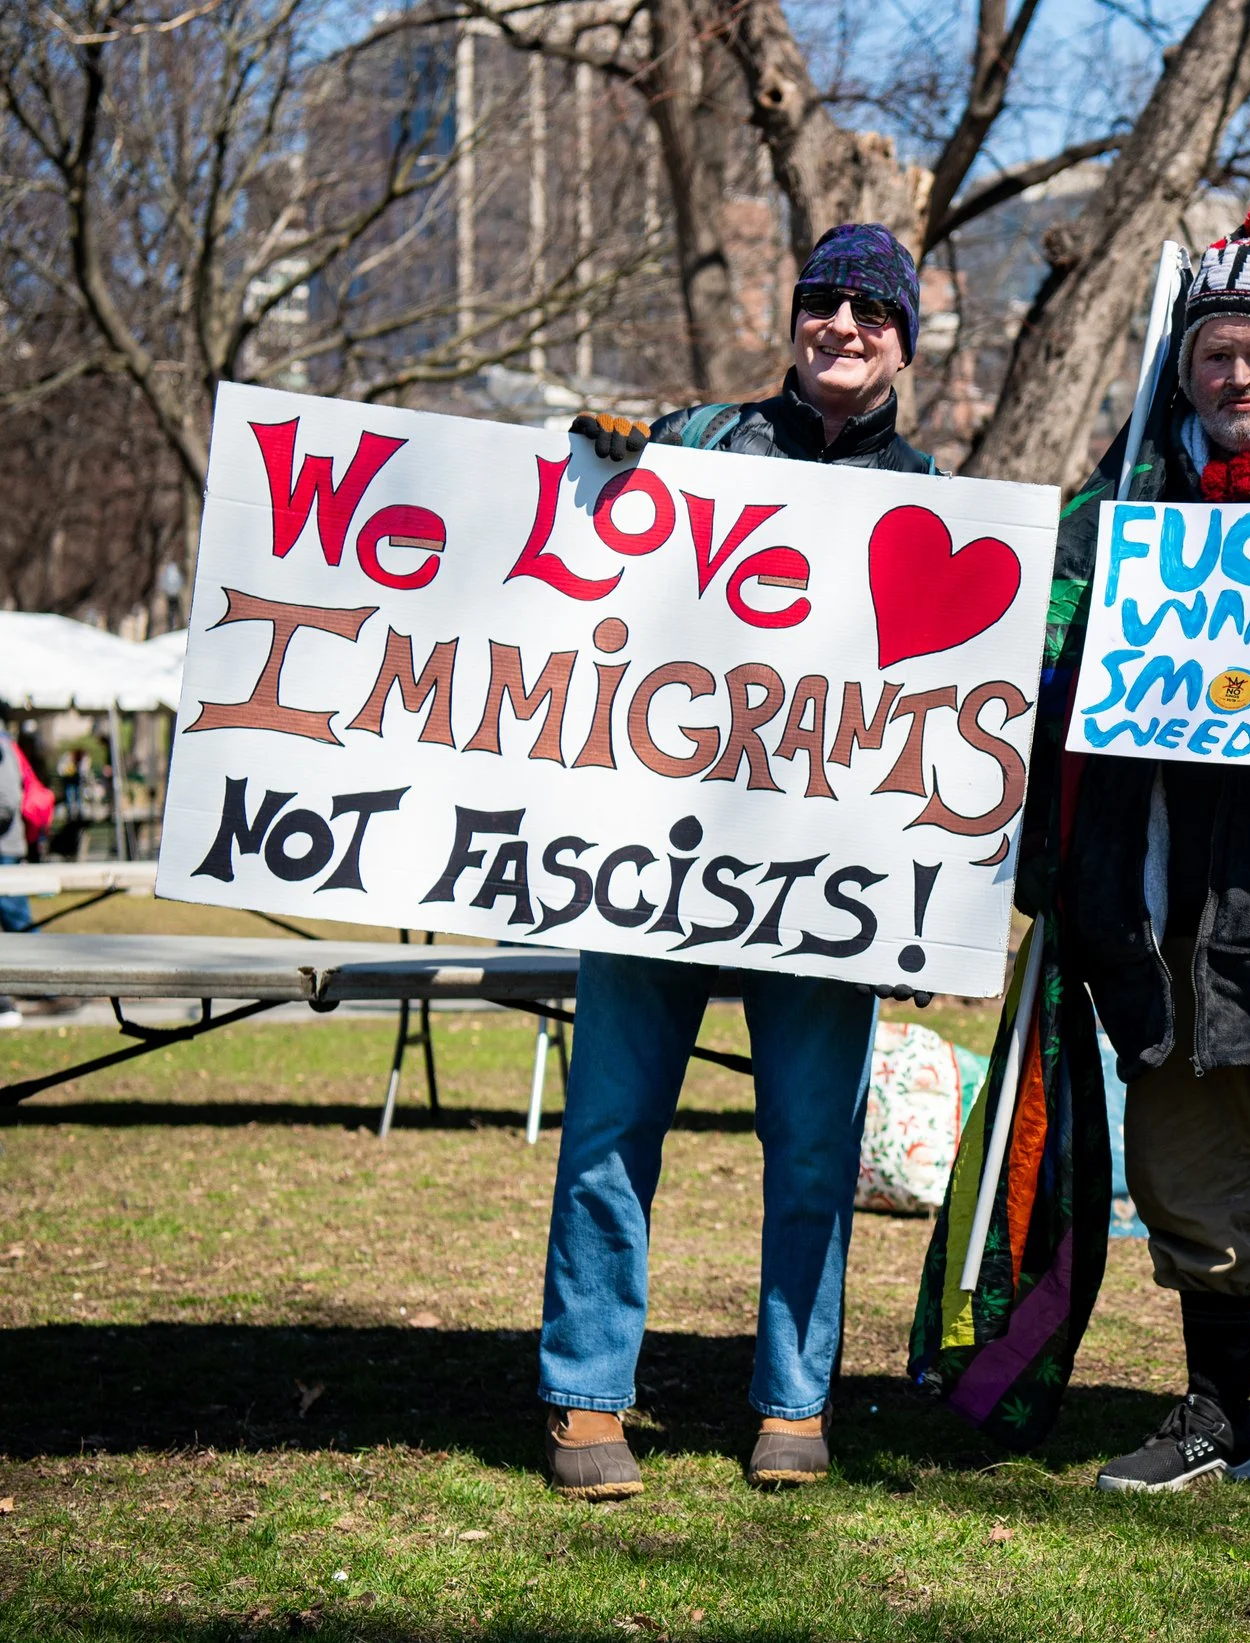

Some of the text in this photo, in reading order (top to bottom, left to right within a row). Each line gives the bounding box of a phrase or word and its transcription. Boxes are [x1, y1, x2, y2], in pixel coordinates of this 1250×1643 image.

[247, 416, 447, 590] We
[1226, 688, 1241, 696] NO
[190, 776, 412, 894] NOT
